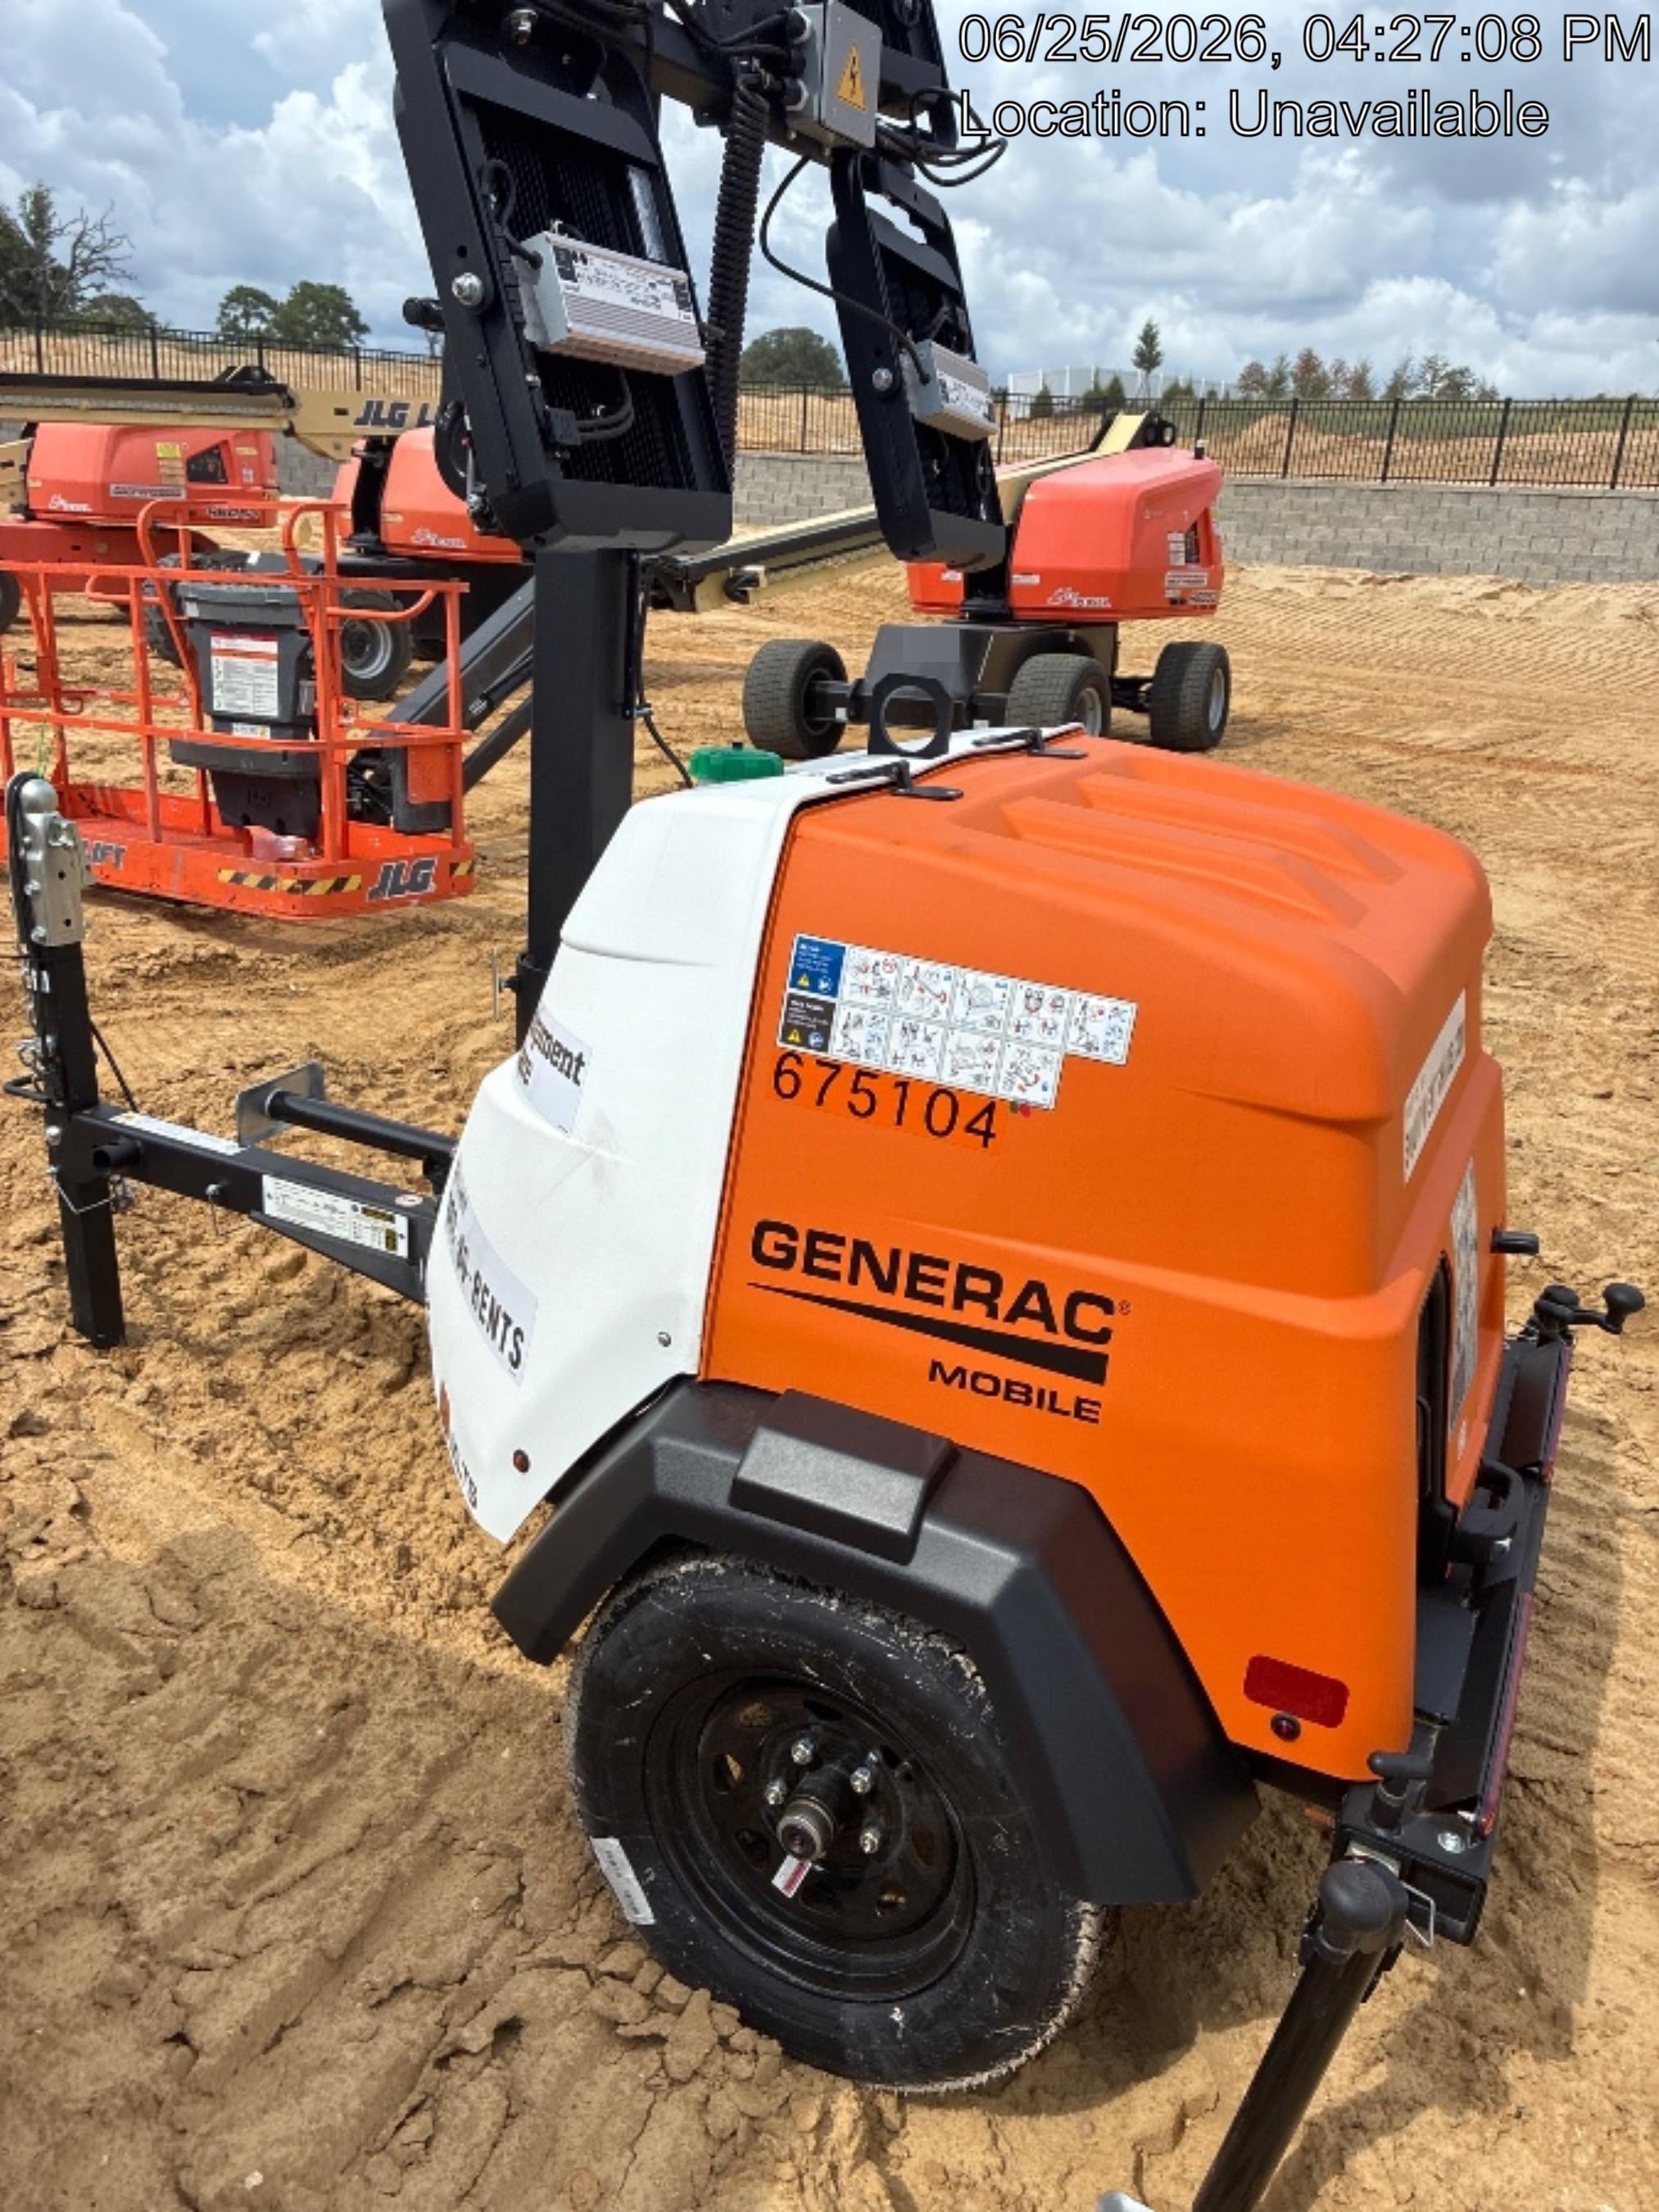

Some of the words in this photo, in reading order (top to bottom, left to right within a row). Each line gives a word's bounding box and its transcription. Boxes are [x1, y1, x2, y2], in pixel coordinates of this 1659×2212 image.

[354, 400, 410, 428] JLG
[366, 858, 437, 902] JLG
[773, 1049, 997, 1149] 675104
[751, 1219, 1115, 1346] GENERAC
[929, 1360, 1102, 1424] MOBILE
